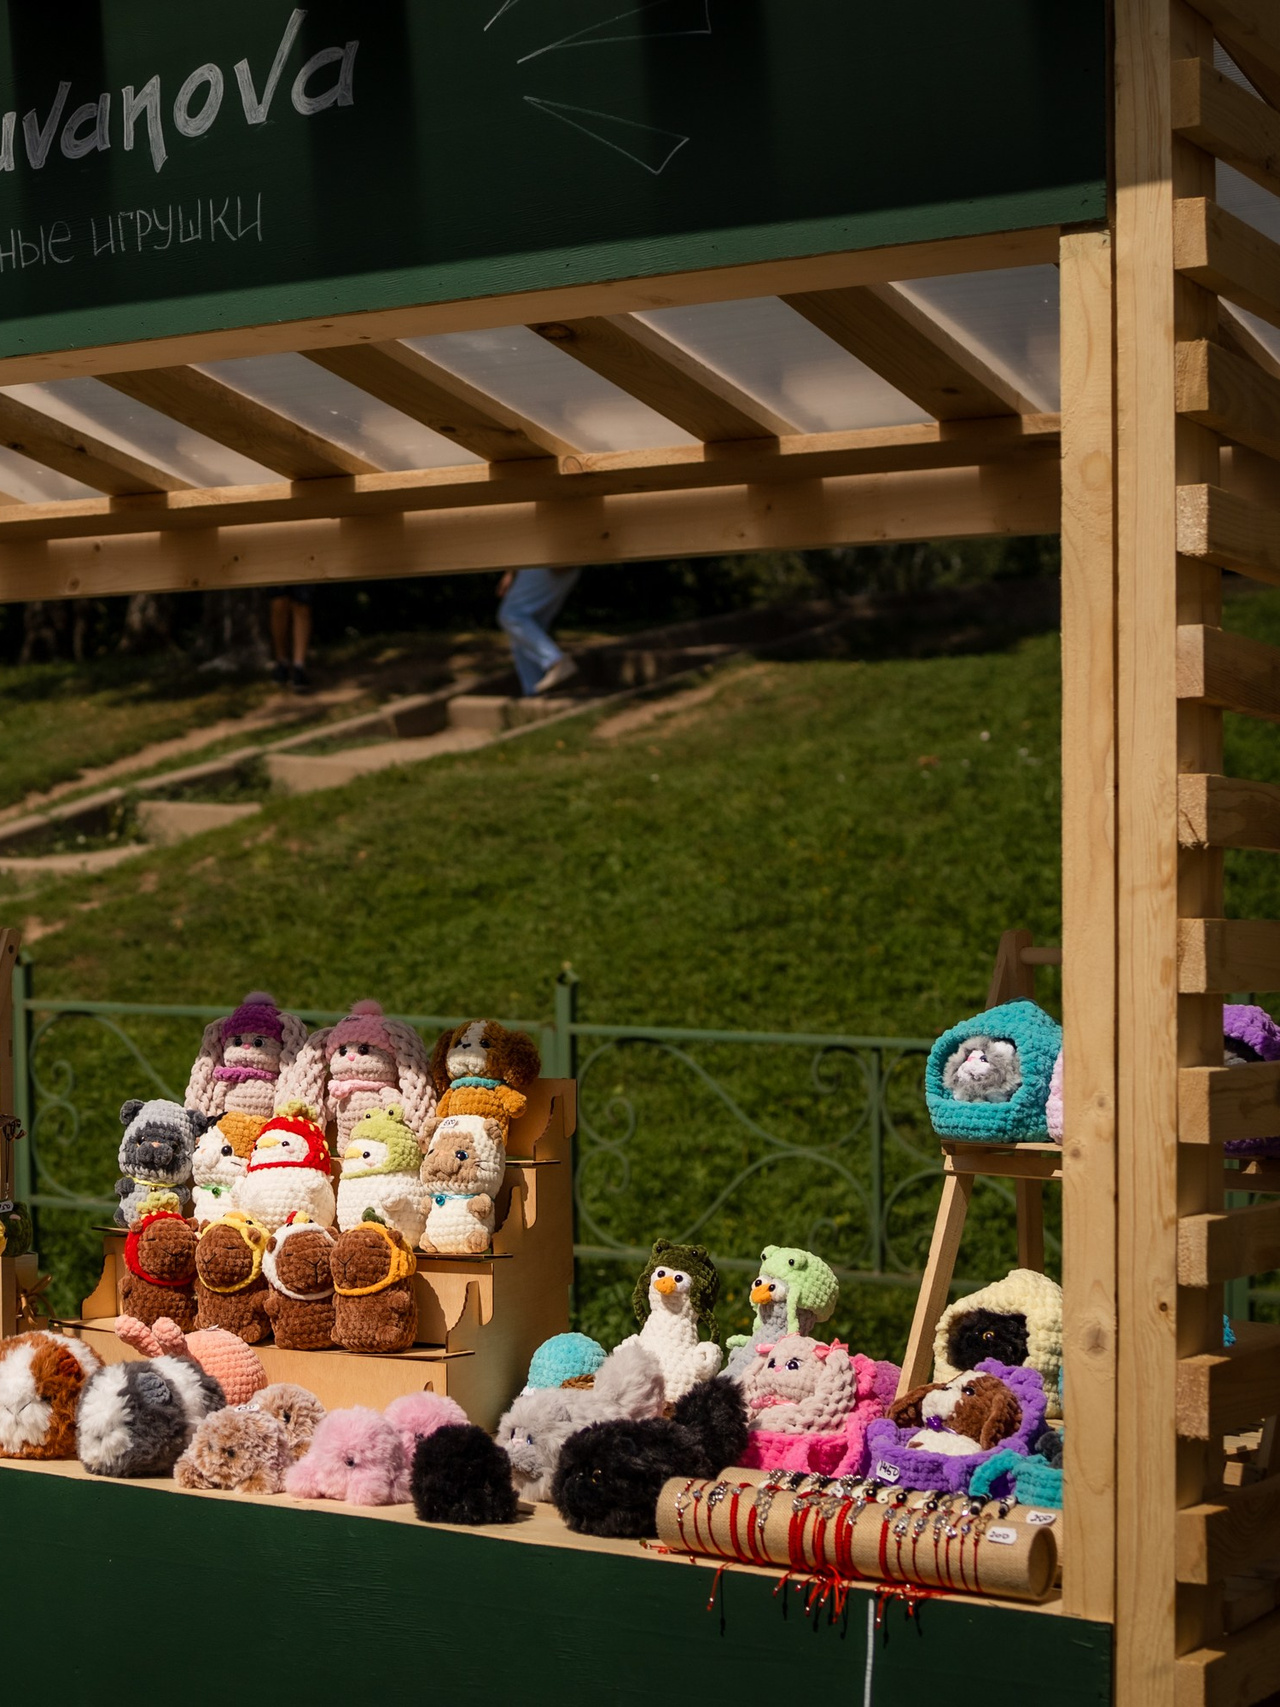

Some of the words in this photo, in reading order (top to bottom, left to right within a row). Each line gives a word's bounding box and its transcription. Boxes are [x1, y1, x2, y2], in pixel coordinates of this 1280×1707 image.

[91, 192, 264, 258] ИГРУШКИ
[880, 1460, 899, 1477] 1450
[989, 1531, 1010, 1540] 200
